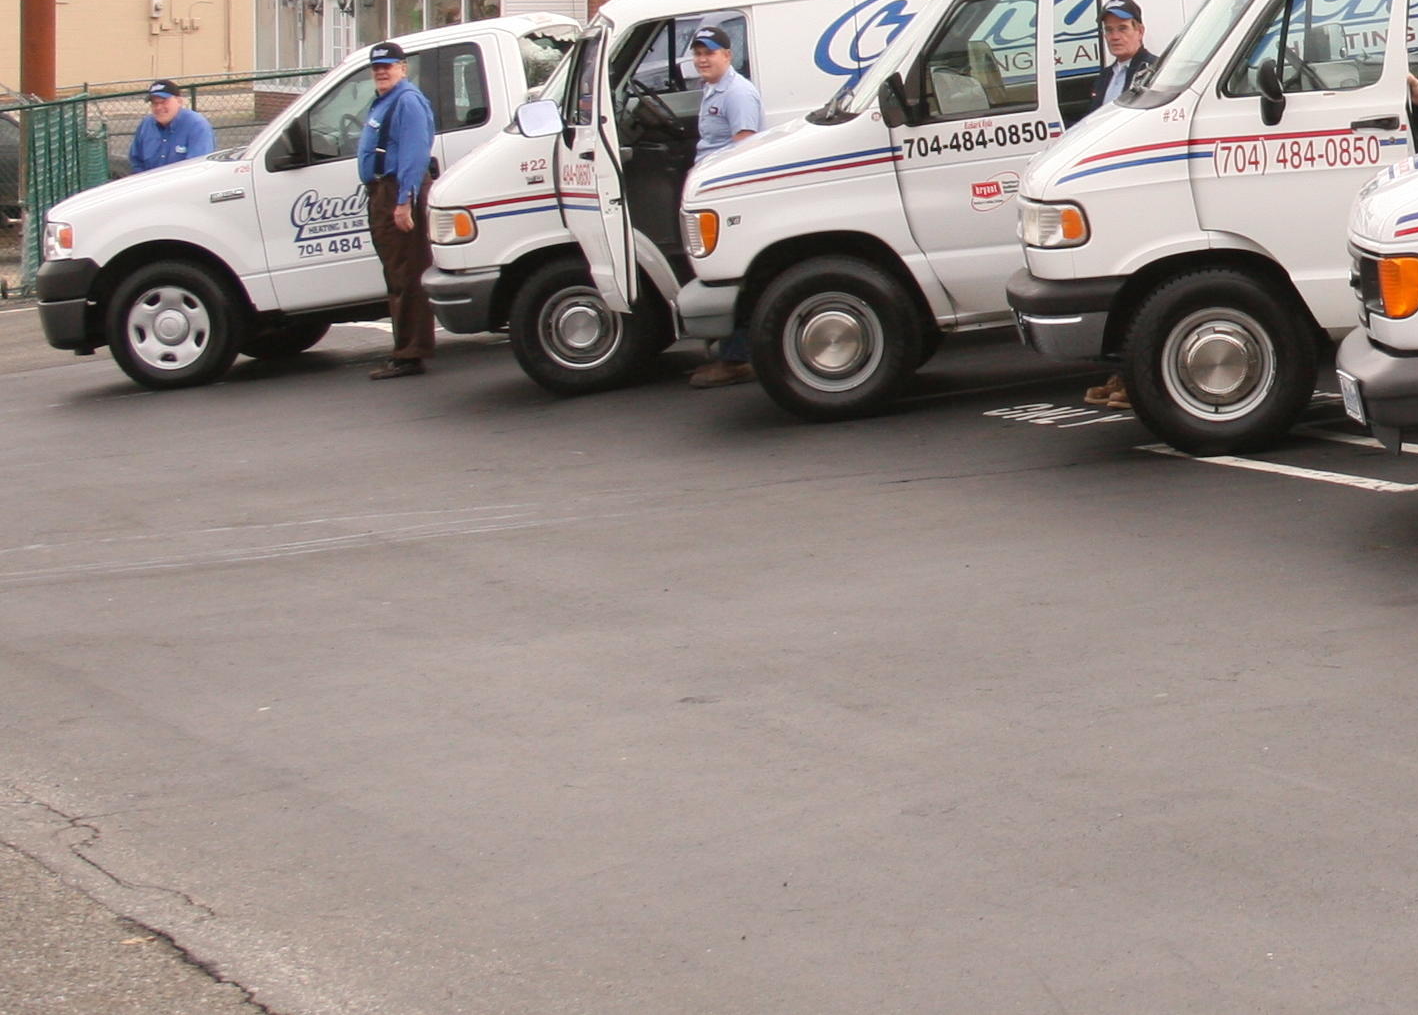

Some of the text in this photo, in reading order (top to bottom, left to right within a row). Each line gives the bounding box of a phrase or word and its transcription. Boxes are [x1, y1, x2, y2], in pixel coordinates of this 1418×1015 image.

[1162, 108, 1186, 122] #24
[903, 120, 1048, 160] 704-484-0850
[1212, 135, 1381, 179] (704) 484-0850
[519, 158, 548, 173] #22
[308, 223, 339, 235] HEATING
[297, 243, 324, 256] 704
